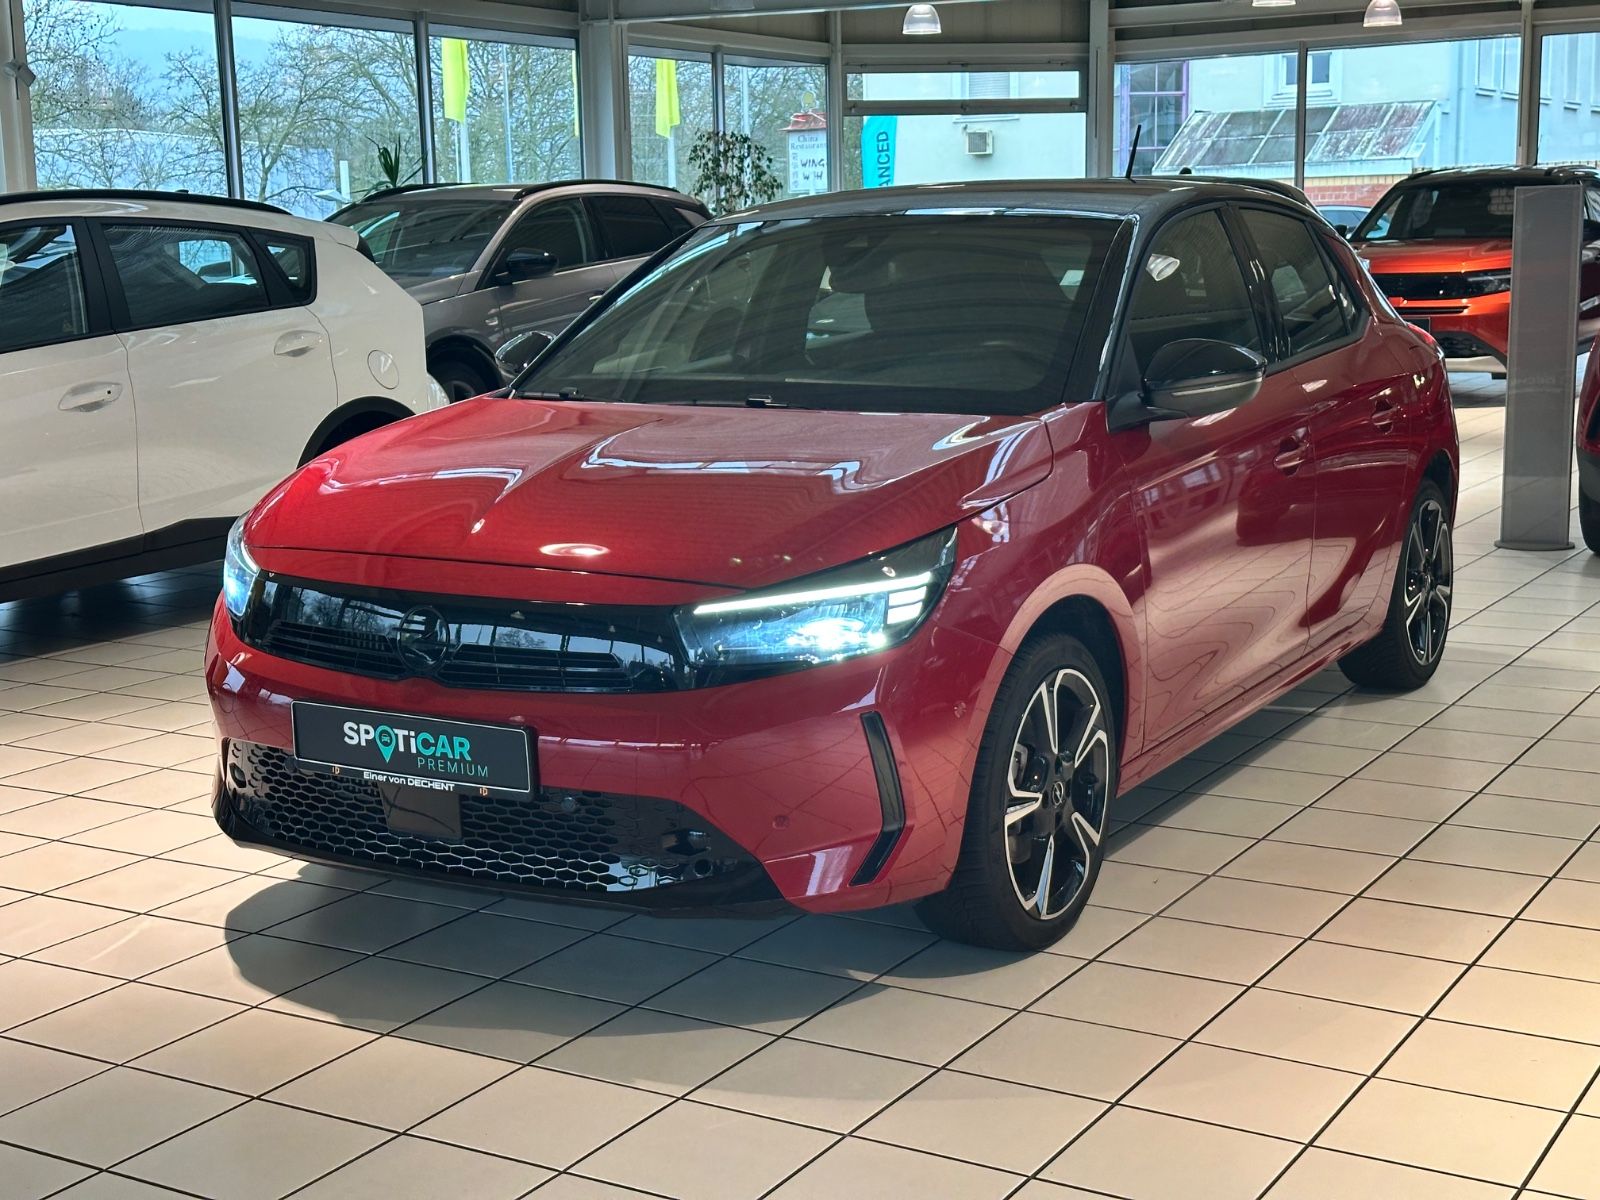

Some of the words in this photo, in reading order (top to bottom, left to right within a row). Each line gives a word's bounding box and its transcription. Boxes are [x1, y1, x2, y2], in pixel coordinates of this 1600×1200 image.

[417, 757, 489, 778] PREMIUM
[363, 771, 387, 782] Einer
[388, 776, 406, 785] von
[407, 777, 455, 792] DECHENT
